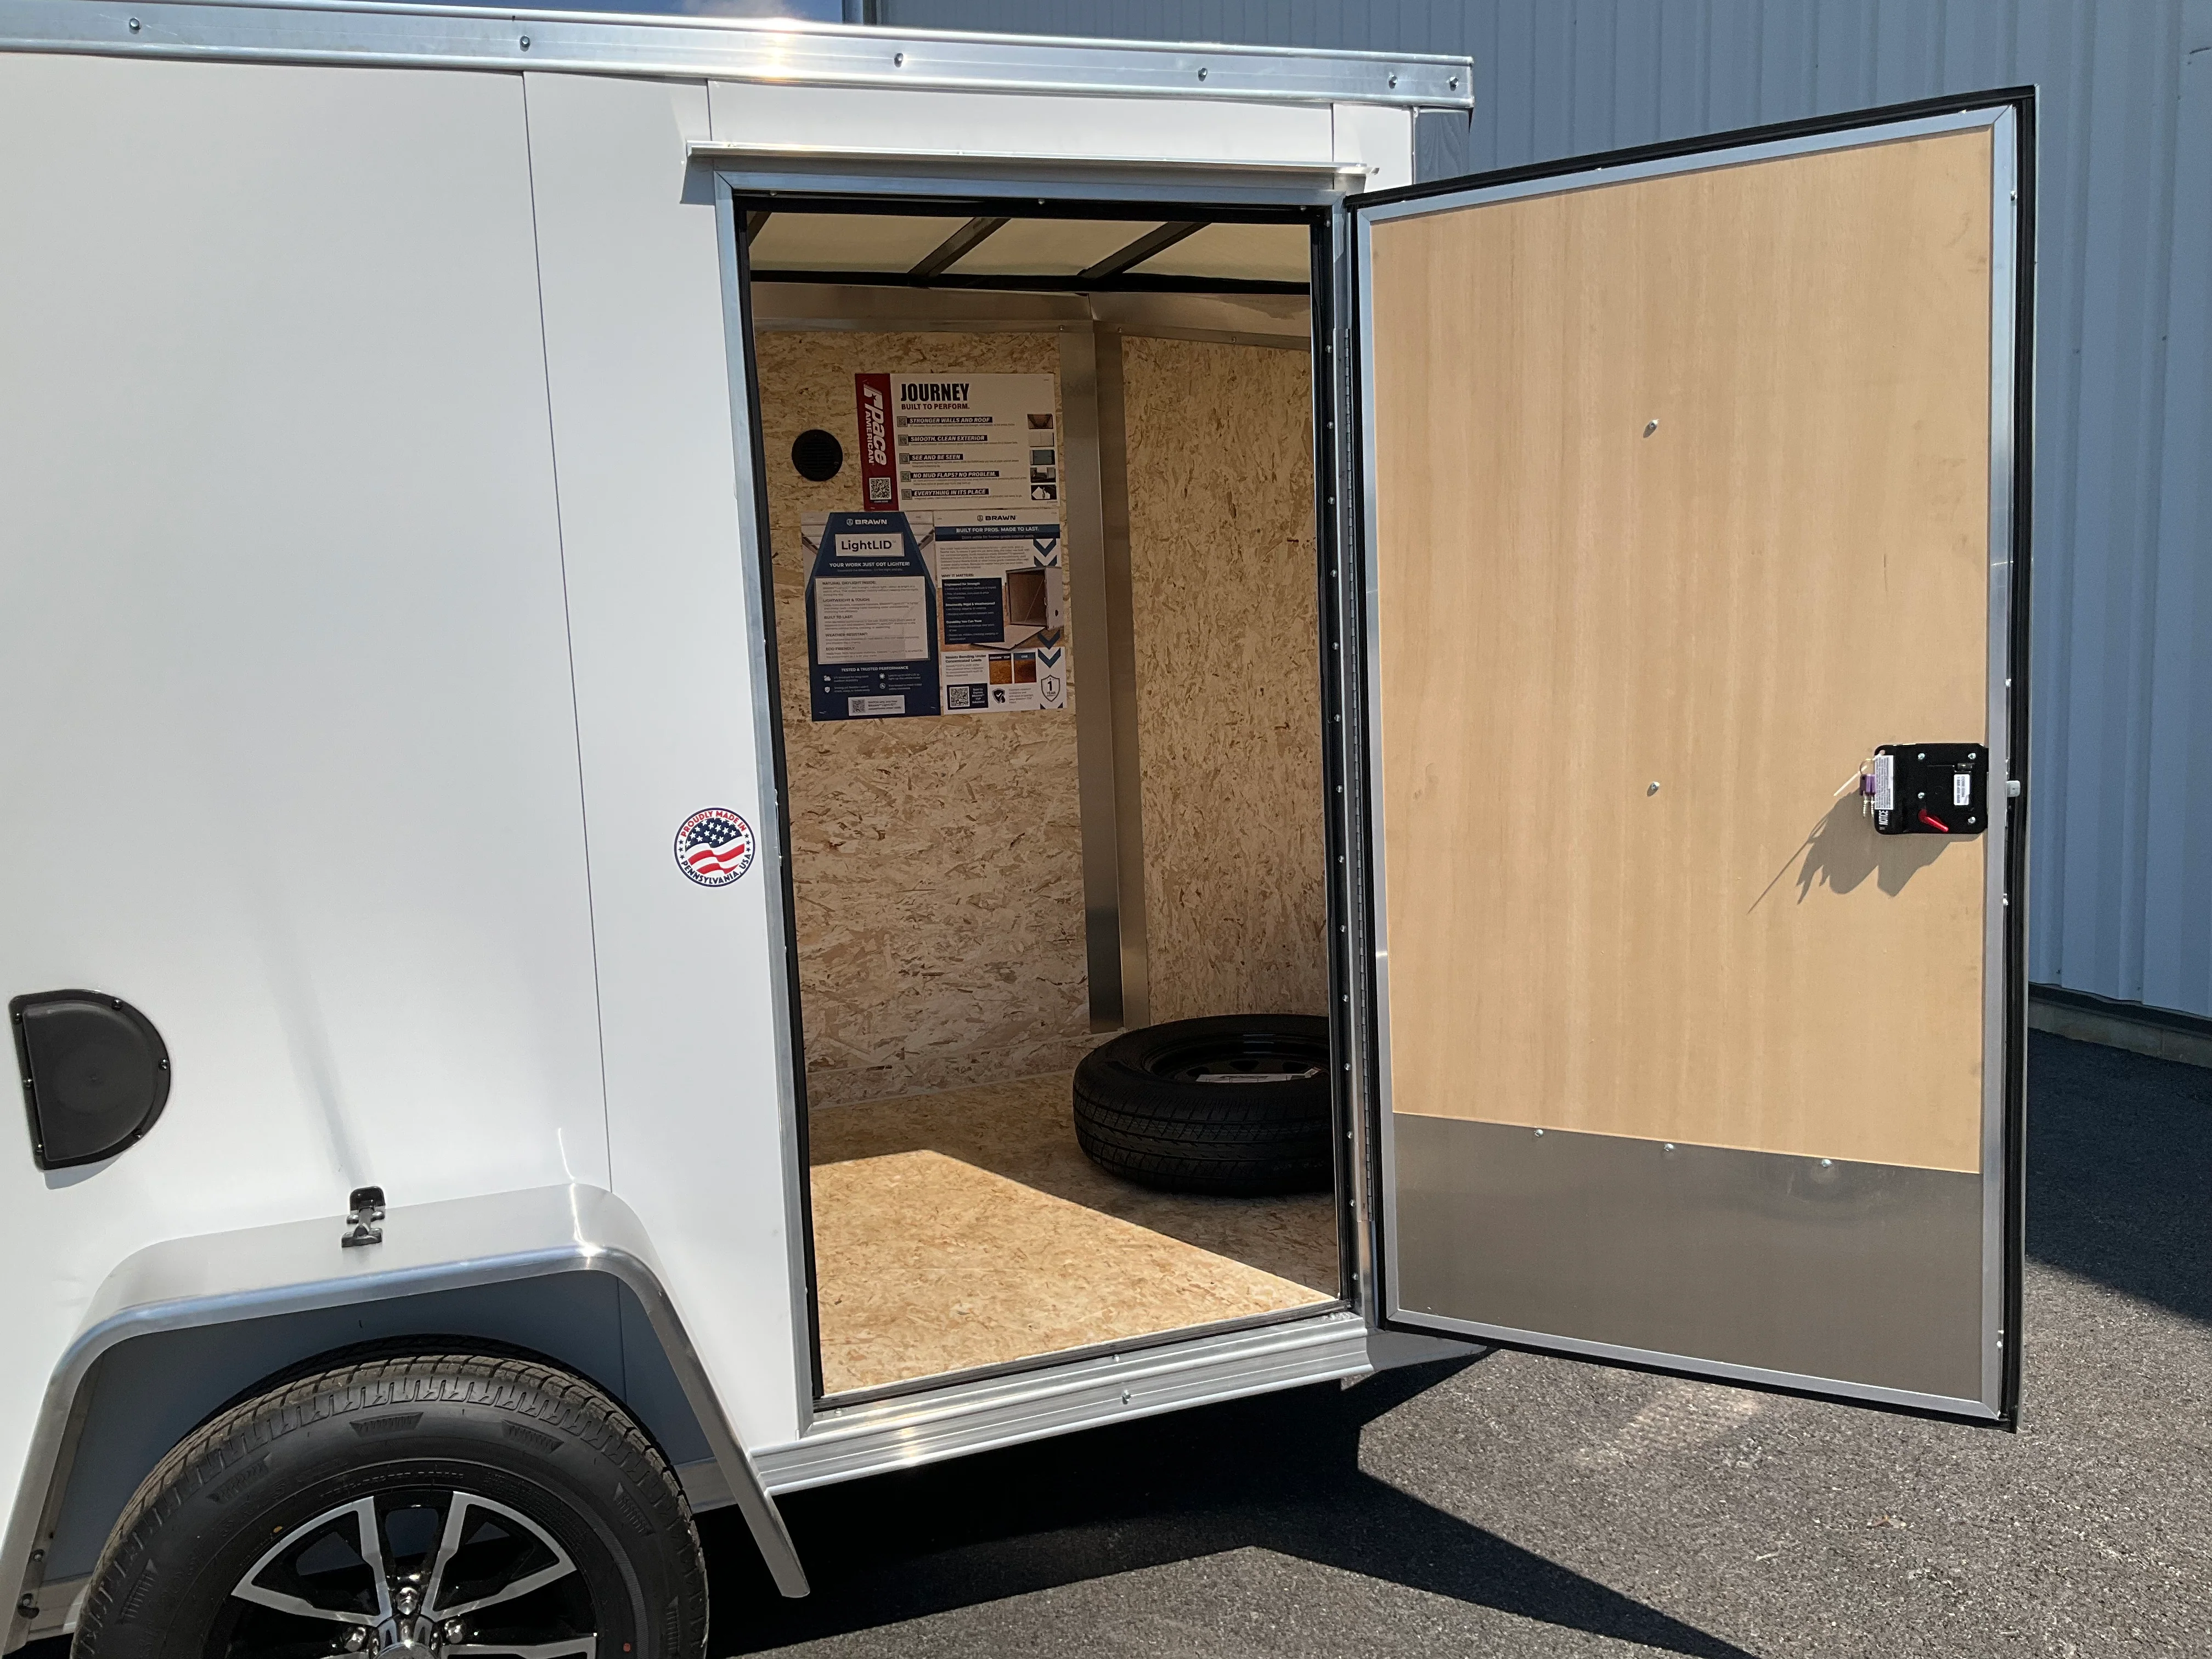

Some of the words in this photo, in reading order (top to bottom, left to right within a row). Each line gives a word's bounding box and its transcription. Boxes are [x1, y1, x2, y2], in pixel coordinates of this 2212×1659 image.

[901, 383, 969, 402] JOURNEY
[865, 411, 874, 465] AMERICAN
[1047, 681, 1052, 691] 1
[680, 811, 713, 837] PROUDLY
[715, 810, 739, 823] MADE
[738, 822, 747, 832] IN
[1878, 810, 1889, 826] NOTICE
[739, 854, 752, 870] USA
